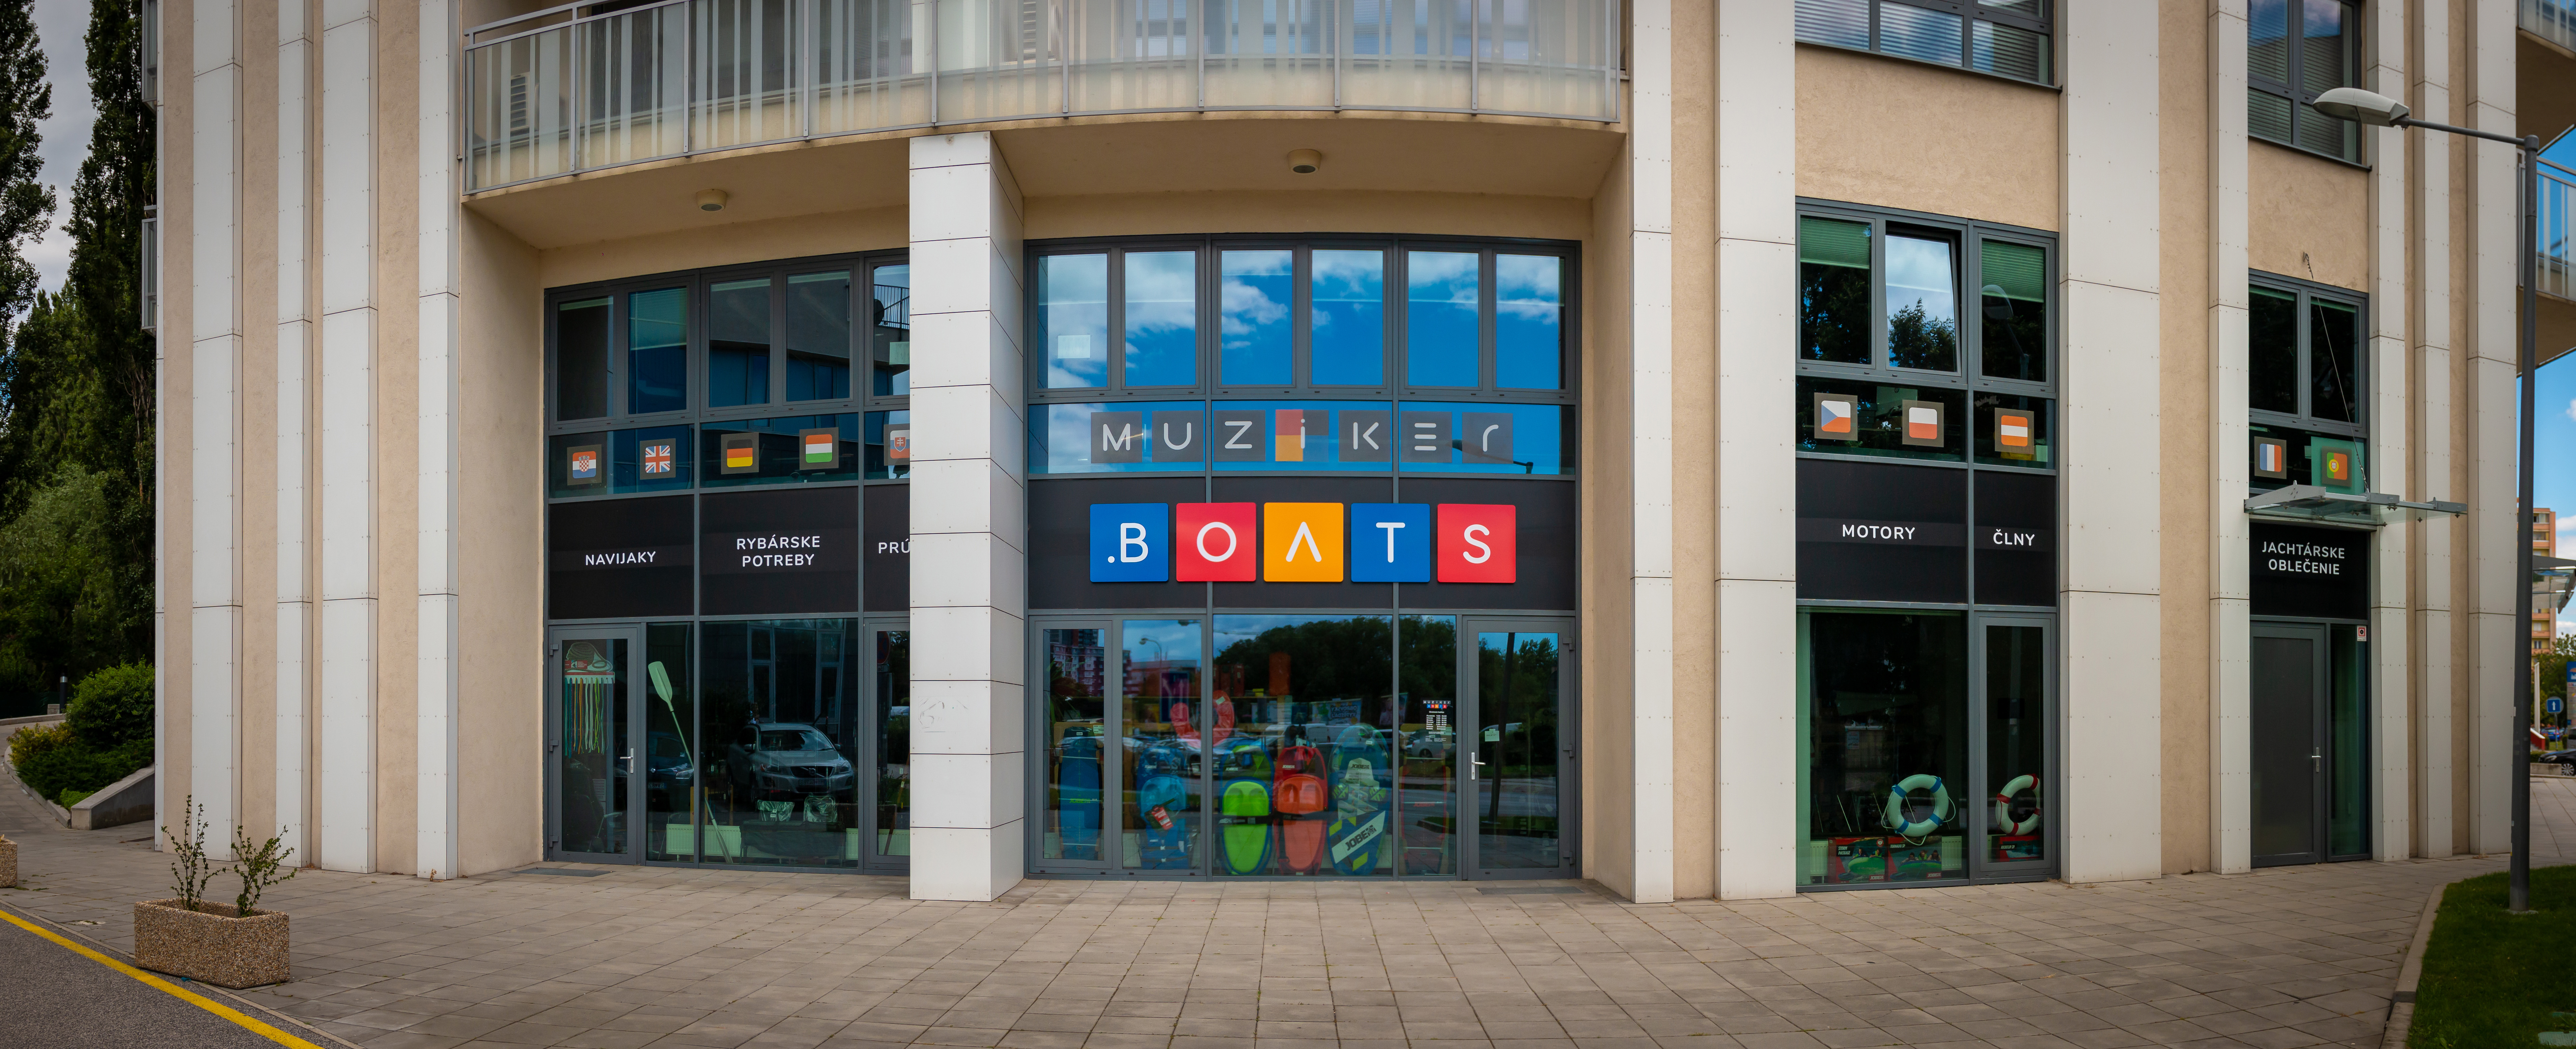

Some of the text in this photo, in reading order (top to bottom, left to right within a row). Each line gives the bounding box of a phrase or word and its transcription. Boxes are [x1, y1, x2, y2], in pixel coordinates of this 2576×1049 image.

[1843, 524, 1915, 540] MOTORY
[1993, 529, 2035, 546] ČLNY
[737, 534, 820, 550] RYBÁRSKE
[2262, 541, 2345, 559] JACHTÁRSKE
[586, 551, 656, 566] NAVIJAKY
[743, 554, 814, 567] POTREBY
[2269, 559, 2340, 574] OBLEČENIE
